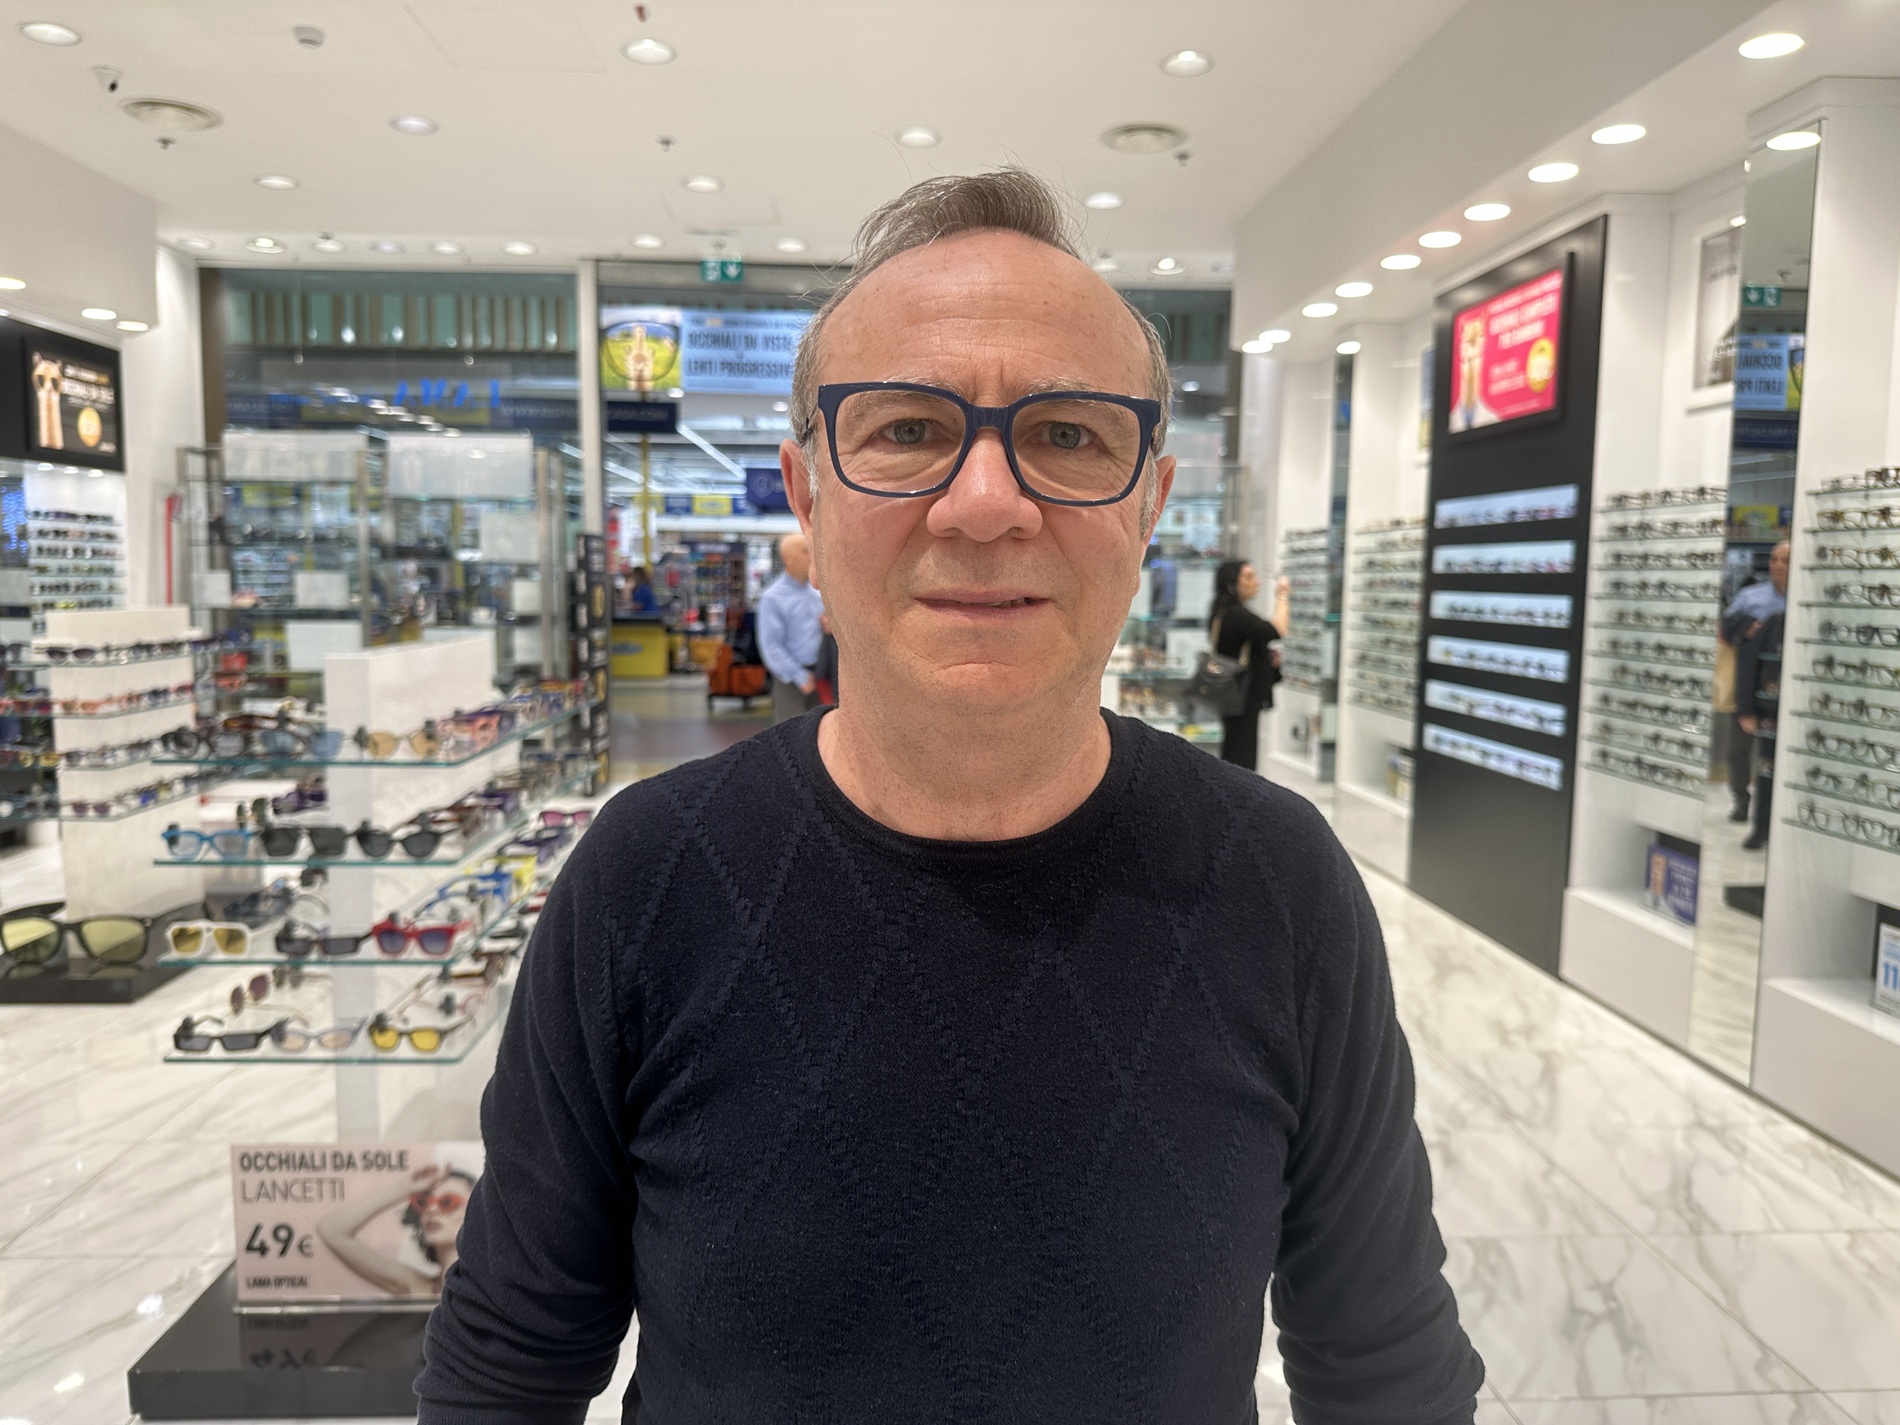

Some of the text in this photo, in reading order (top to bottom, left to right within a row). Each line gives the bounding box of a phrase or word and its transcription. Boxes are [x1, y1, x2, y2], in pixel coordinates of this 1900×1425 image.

[239, 1150, 410, 1172] OCCHIALI DA SOLE
[241, 1177, 346, 1203] LANCETTI
[245, 1222, 315, 1259] 49€
[246, 1275, 309, 1289] LAMA OPTICAL
